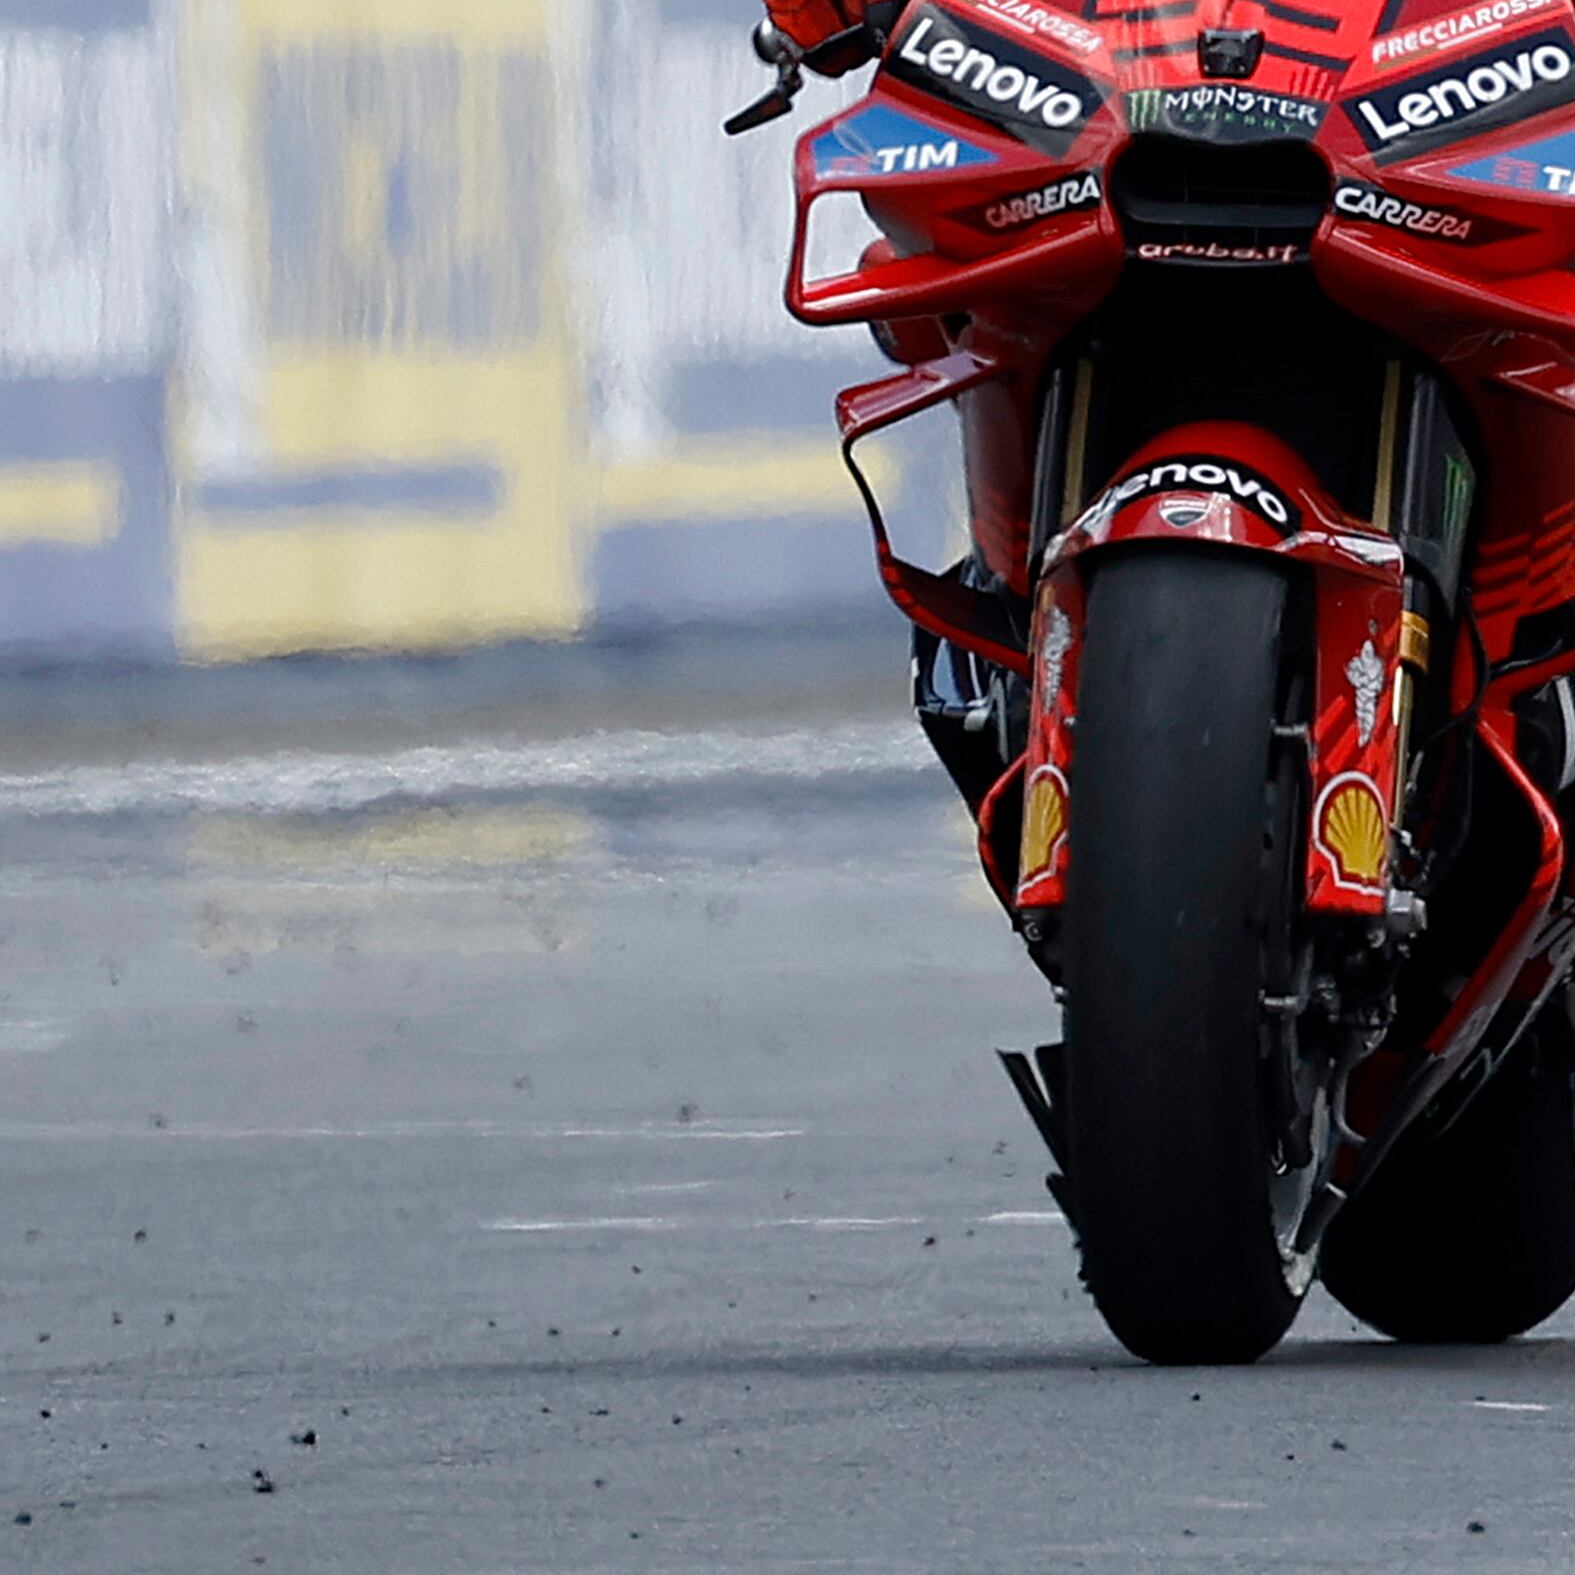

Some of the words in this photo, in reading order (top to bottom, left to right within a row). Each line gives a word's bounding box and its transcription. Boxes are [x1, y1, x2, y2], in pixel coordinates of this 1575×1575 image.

[900, 17, 1082, 127] Lenovo
[1358, 45, 1571, 141] Lenovo
[1164, 85, 1319, 127] MONSTER
[876, 140, 959, 173] TIM
[985, 174, 1101, 228] CARRERA
[1335, 186, 1472, 239] CARRERA
[1137, 242, 1298, 264] aruba.it
